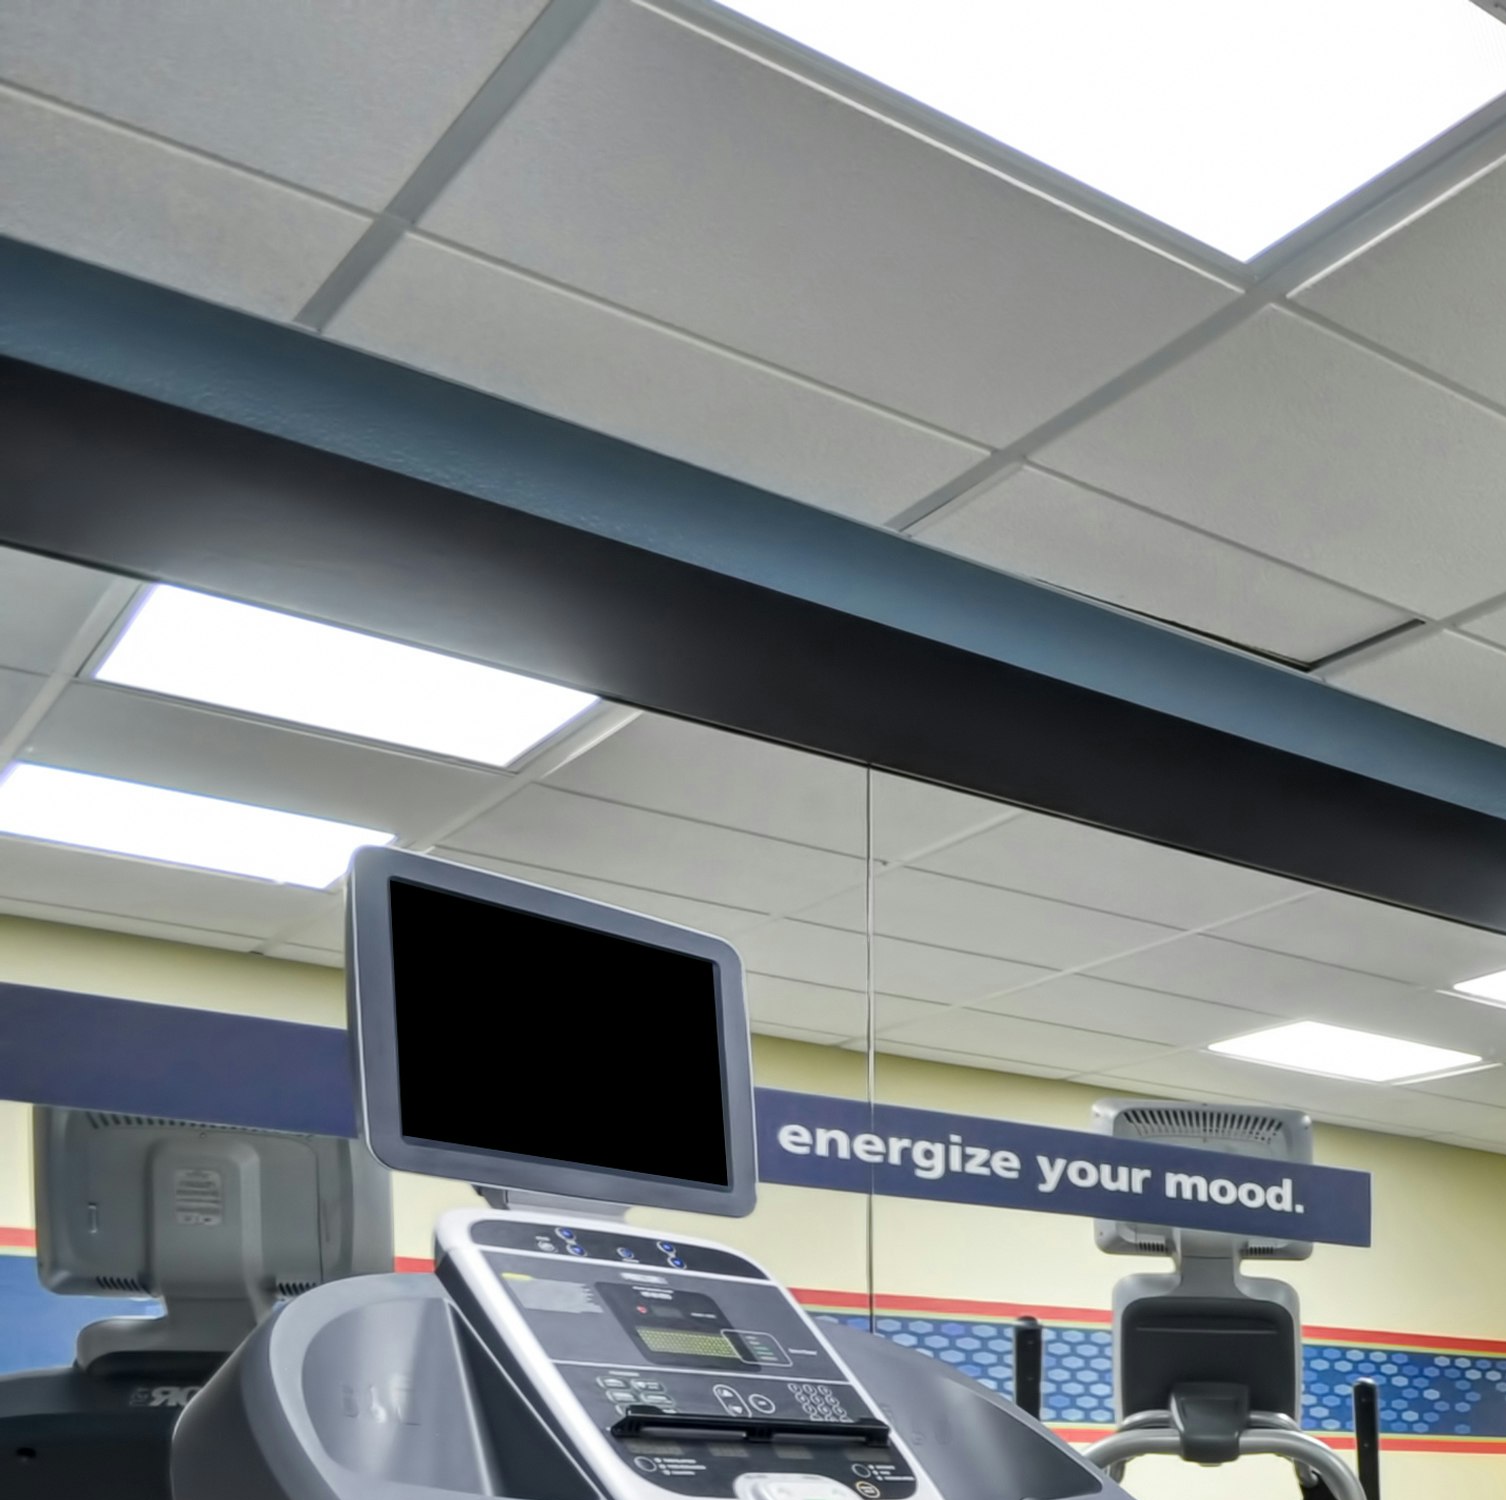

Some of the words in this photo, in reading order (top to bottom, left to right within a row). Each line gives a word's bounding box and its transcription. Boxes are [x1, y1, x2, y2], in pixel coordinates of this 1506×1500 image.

[777, 1123, 1021, 1180] energize
[1036, 1154, 1152, 1194] your
[1165, 1171, 1305, 1214] mood.
